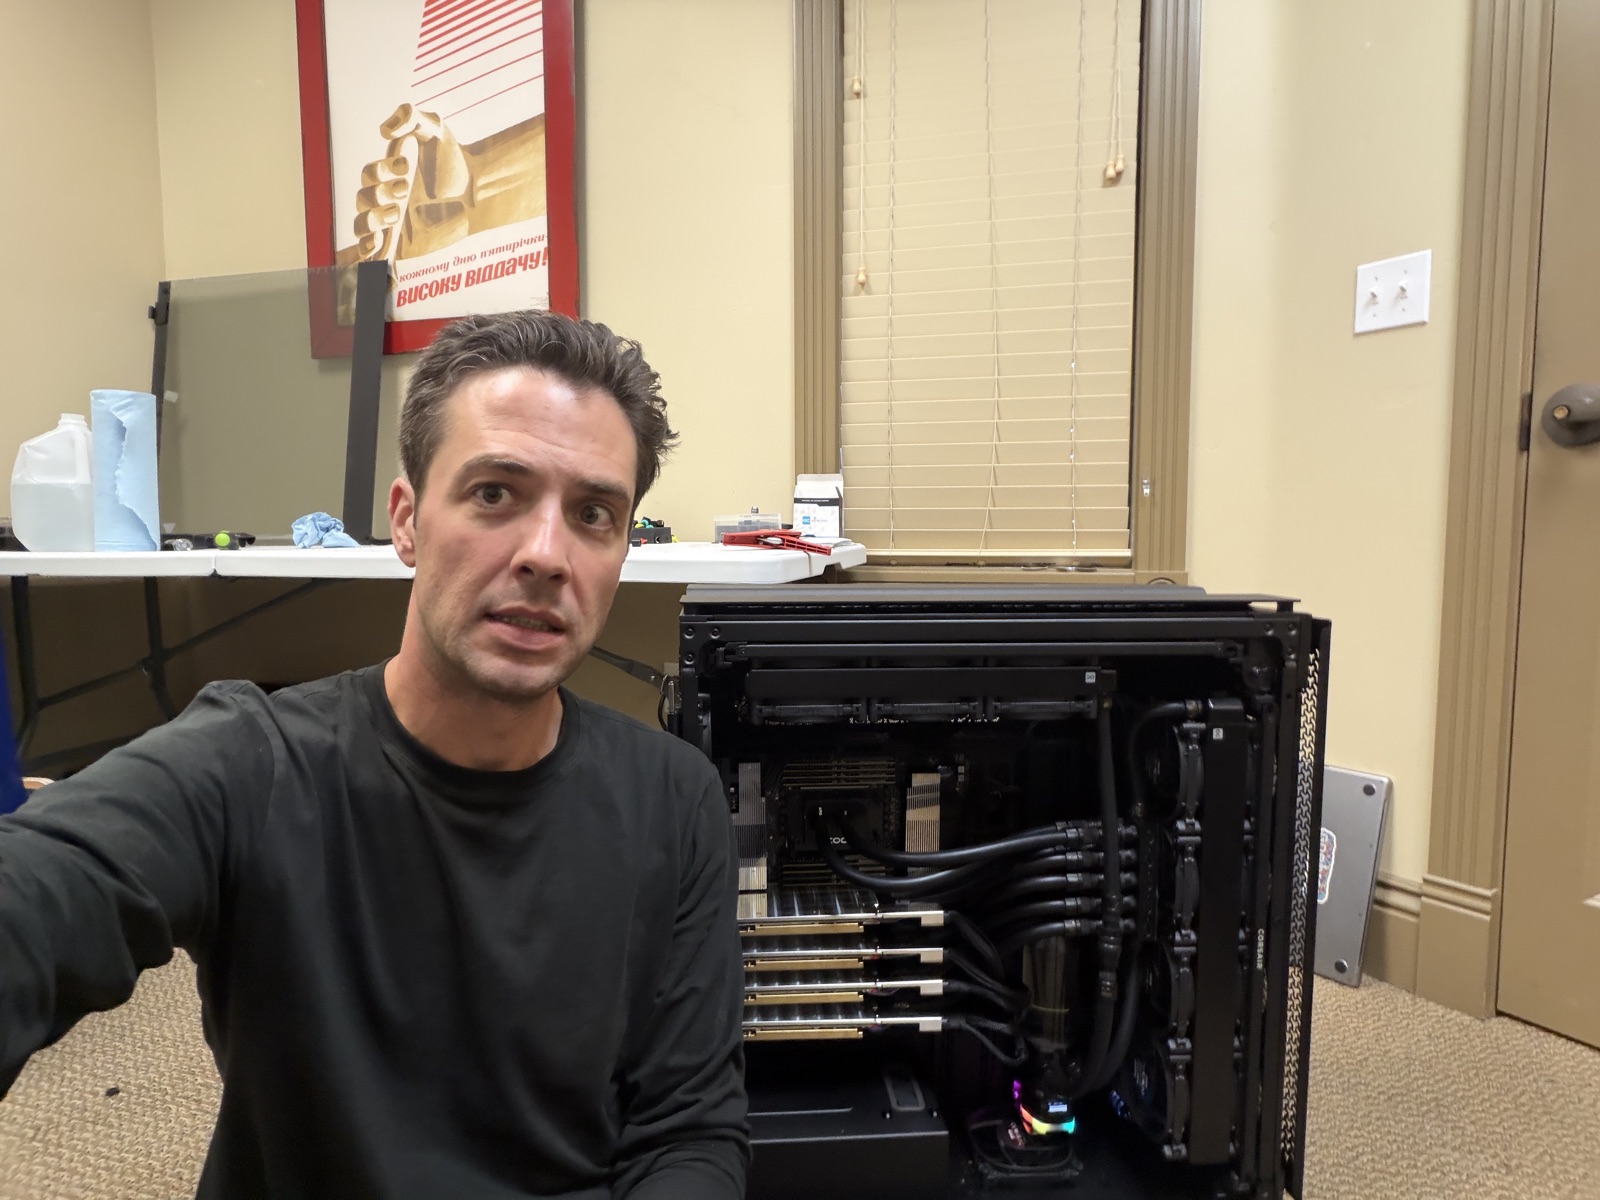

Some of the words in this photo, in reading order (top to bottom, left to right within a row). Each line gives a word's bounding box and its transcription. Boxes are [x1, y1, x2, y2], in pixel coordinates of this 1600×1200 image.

[399, 261, 450, 282] кожному
[452, 253, 477, 266] дню
[1256, 928, 1265, 970] CORSAIR
